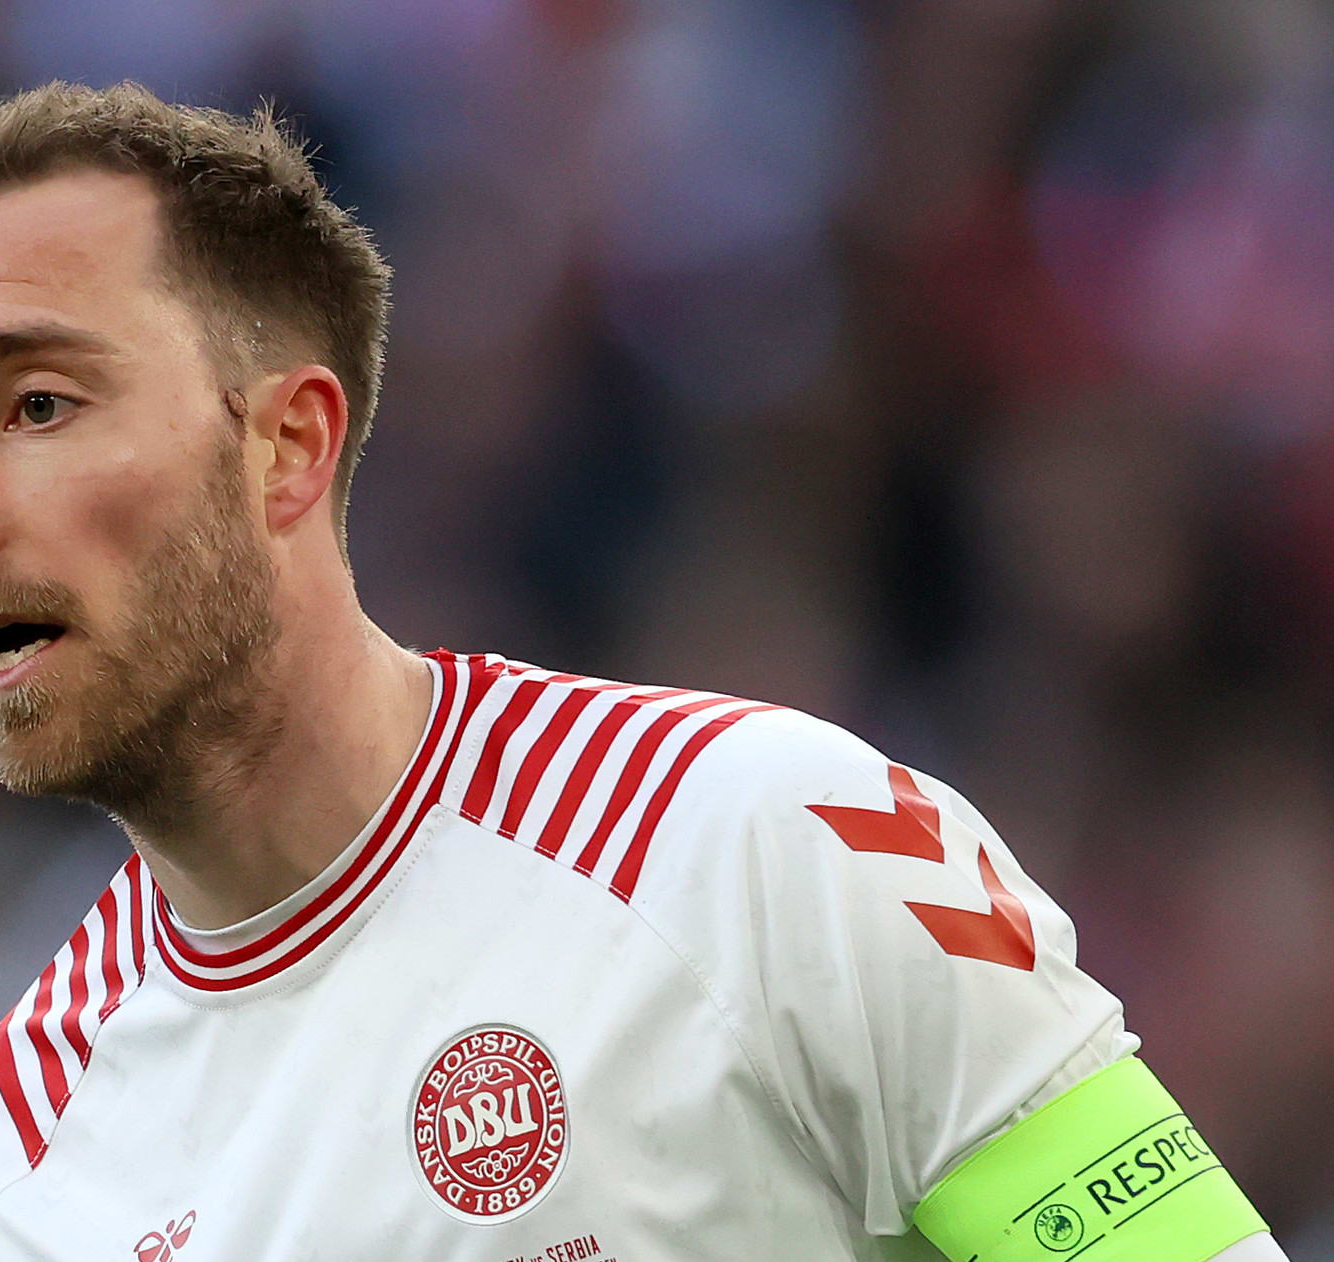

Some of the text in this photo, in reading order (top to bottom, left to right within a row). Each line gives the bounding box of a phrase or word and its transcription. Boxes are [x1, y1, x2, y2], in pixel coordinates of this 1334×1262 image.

[443, 1083, 538, 1157] DBU
[417, 1100, 467, 1205] DANSK
[473, 1177, 536, 1214] 1889
[1038, 1207, 1062, 1226] UEFA
